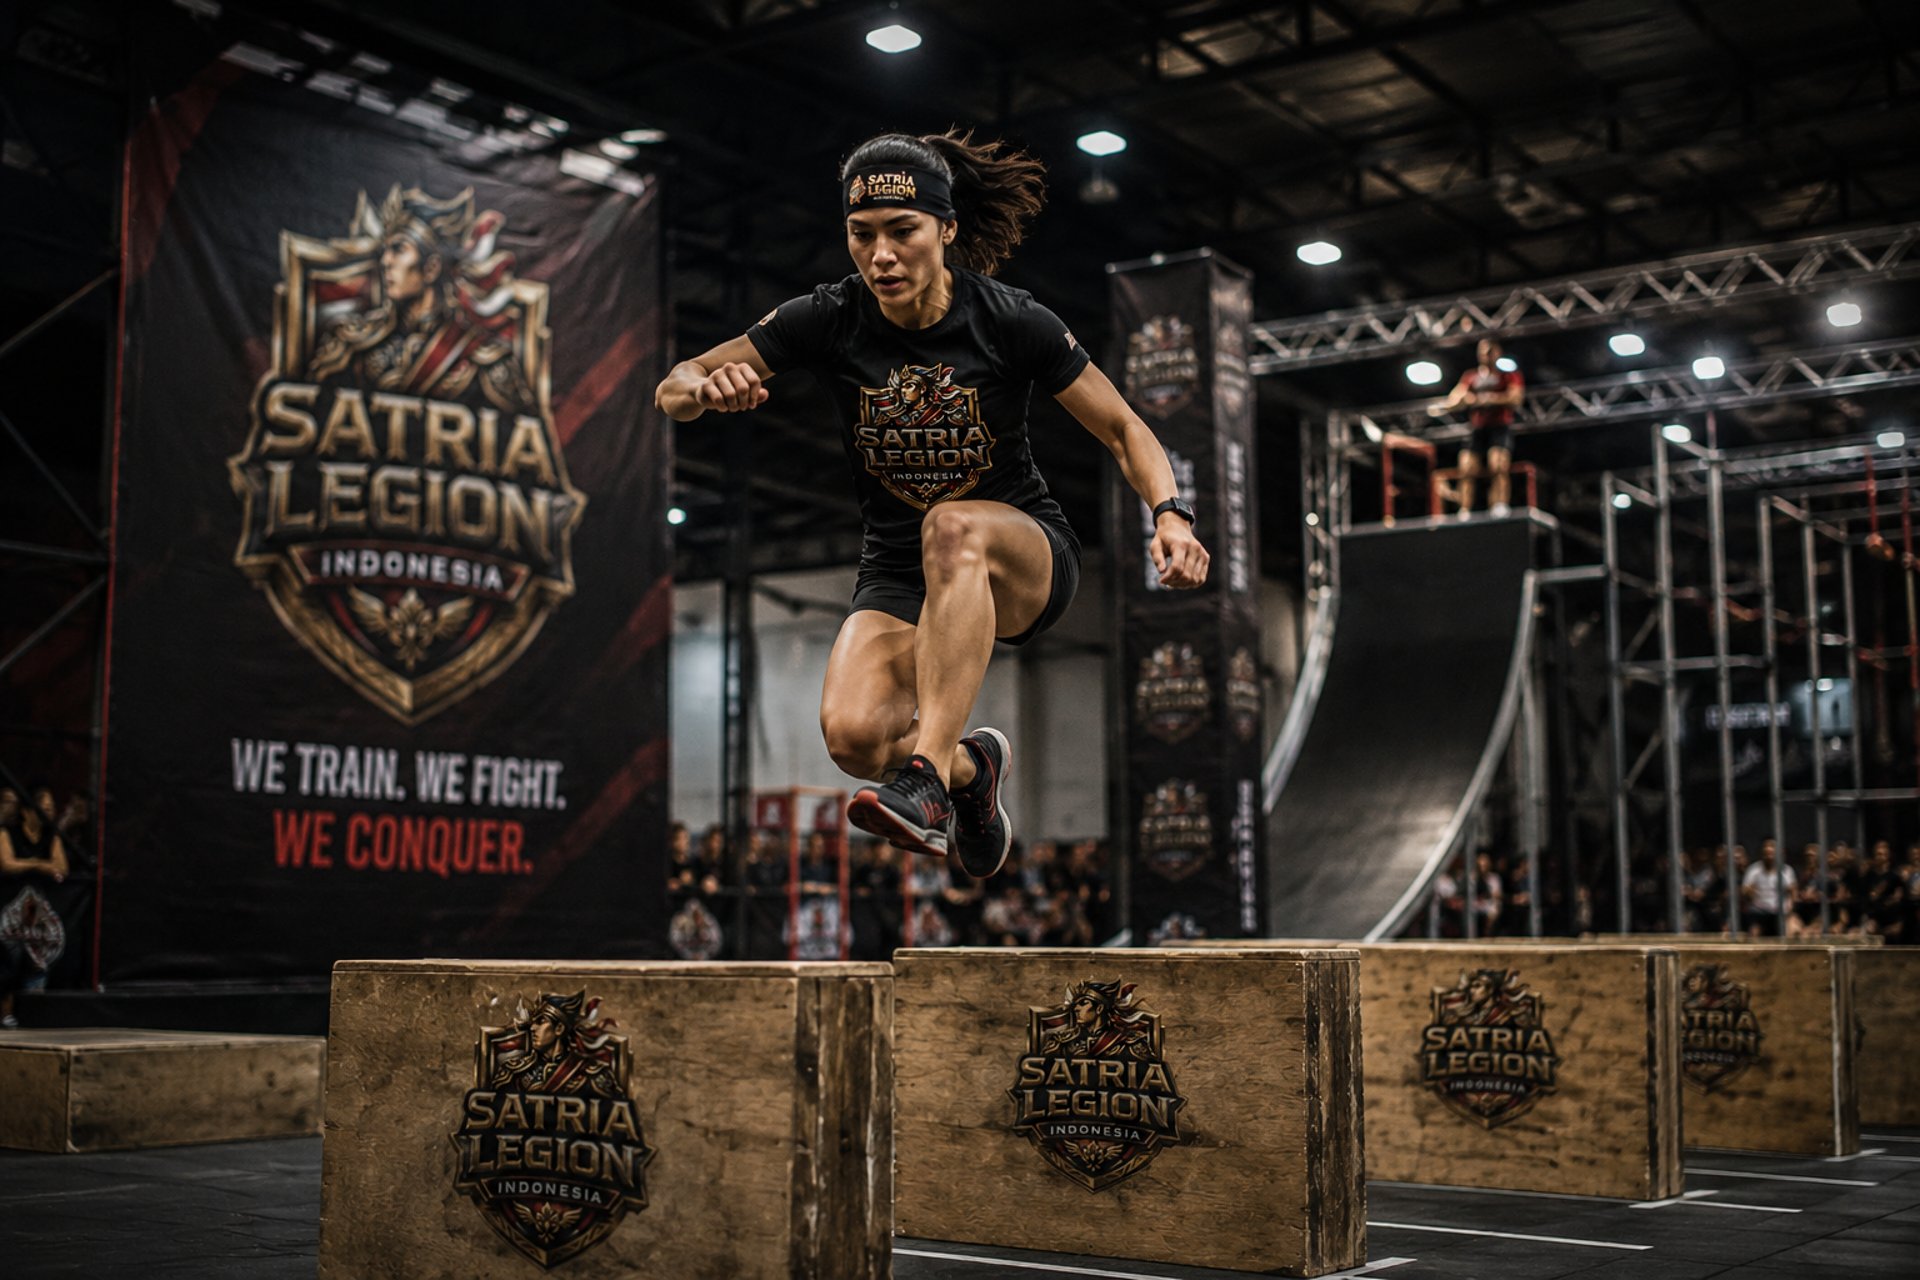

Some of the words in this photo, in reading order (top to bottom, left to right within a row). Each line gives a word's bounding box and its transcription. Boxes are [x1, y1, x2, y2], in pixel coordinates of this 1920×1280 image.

[259, 382, 556, 486] SATRIA
[858, 426, 988, 449] SATRIA
[865, 444, 987, 468] LEGION
[892, 471, 964, 481] INDONESIA
[265, 459, 577, 564] LEGION
[320, 549, 505, 593] INDONESIA
[231, 738, 287, 794] WE
[294, 742, 406, 800] TRAIN.
[416, 752, 467, 806] WE
[472, 755, 567, 810] FIGHT.
[273, 810, 333, 868] WE
[345, 813, 535, 876] CONQUER.
[1681, 1009, 1753, 1030] TRIA
[1425, 1026, 1551, 1054] SATRIA
[1681, 1029, 1757, 1053] GION
[1019, 1056, 1172, 1093] SATRIA
[1427, 1051, 1556, 1080] LEGION
[465, 1090, 639, 1142] SATRIA
[1022, 1088, 1178, 1128] LEGION
[1050, 1124, 1141, 1141] INDONESIA
[468, 1133, 645, 1188] LEGION
[497, 1180, 603, 1205] INDONESIA
